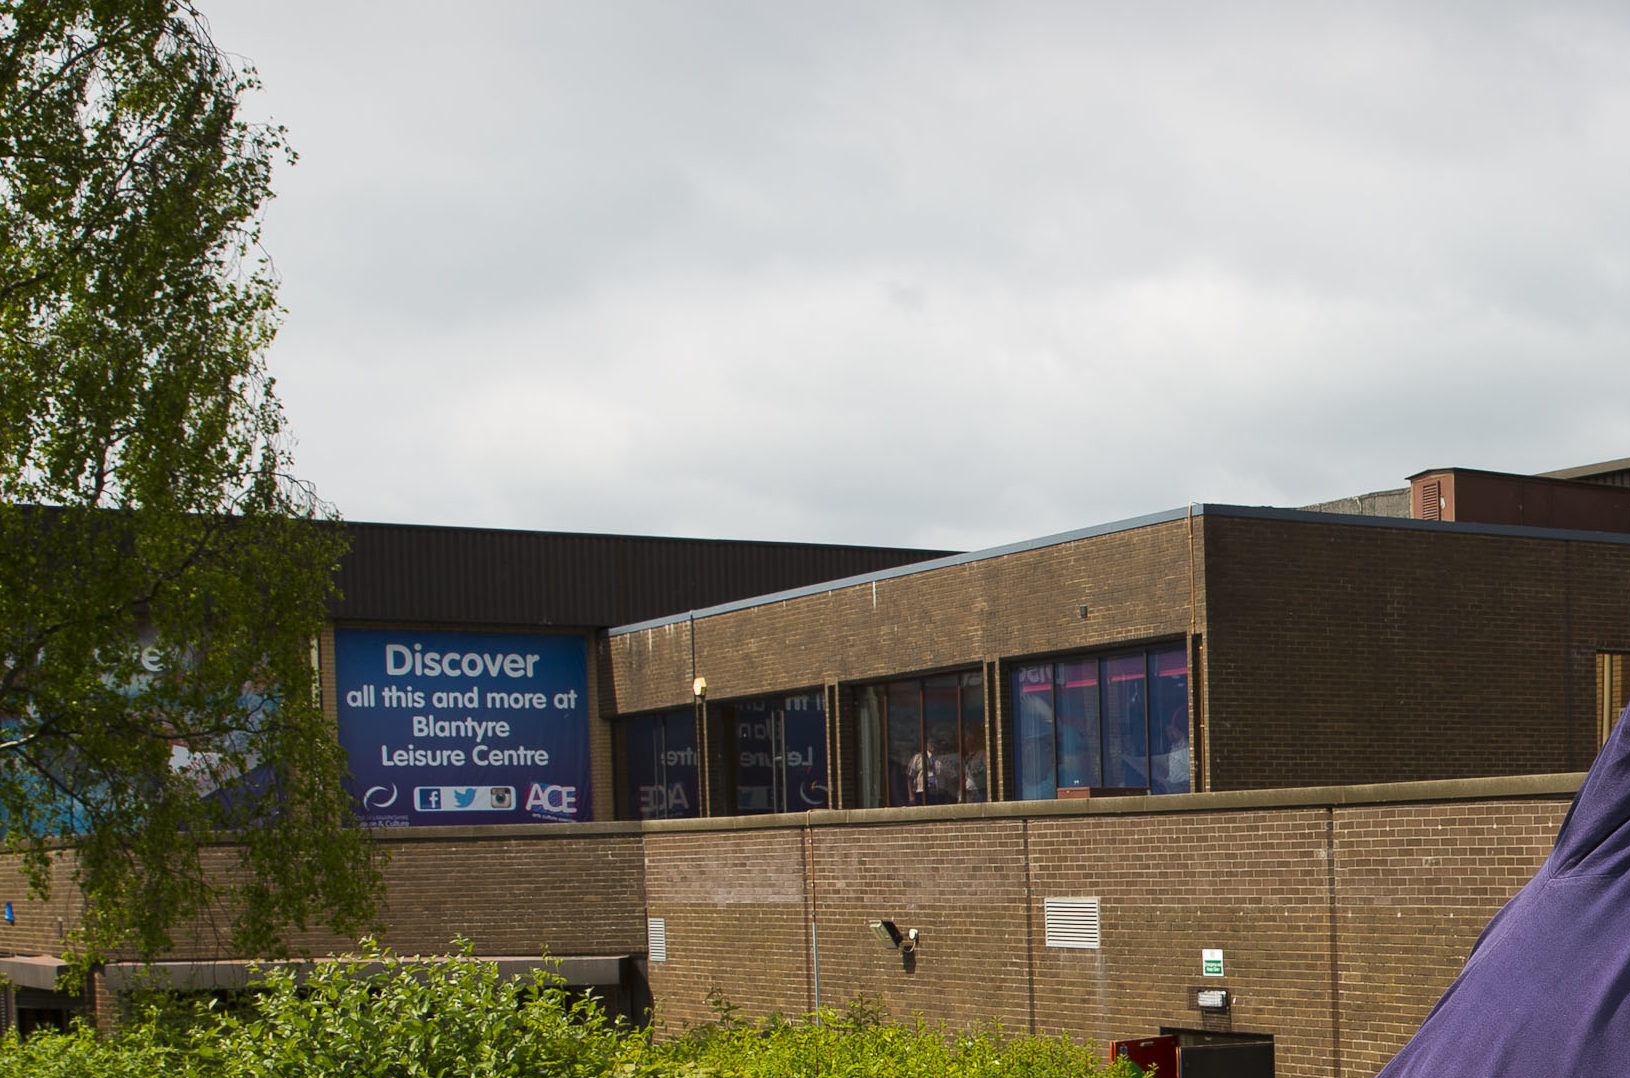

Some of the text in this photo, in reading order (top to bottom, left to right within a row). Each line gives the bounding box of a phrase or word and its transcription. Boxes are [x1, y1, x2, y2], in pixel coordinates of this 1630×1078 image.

[385, 643, 540, 678] Discover
[347, 685, 578, 710] all this and more at
[413, 715, 511, 742] Blantyre
[381, 745, 549, 766] Leisure Centre
[525, 783, 577, 813] ACE
